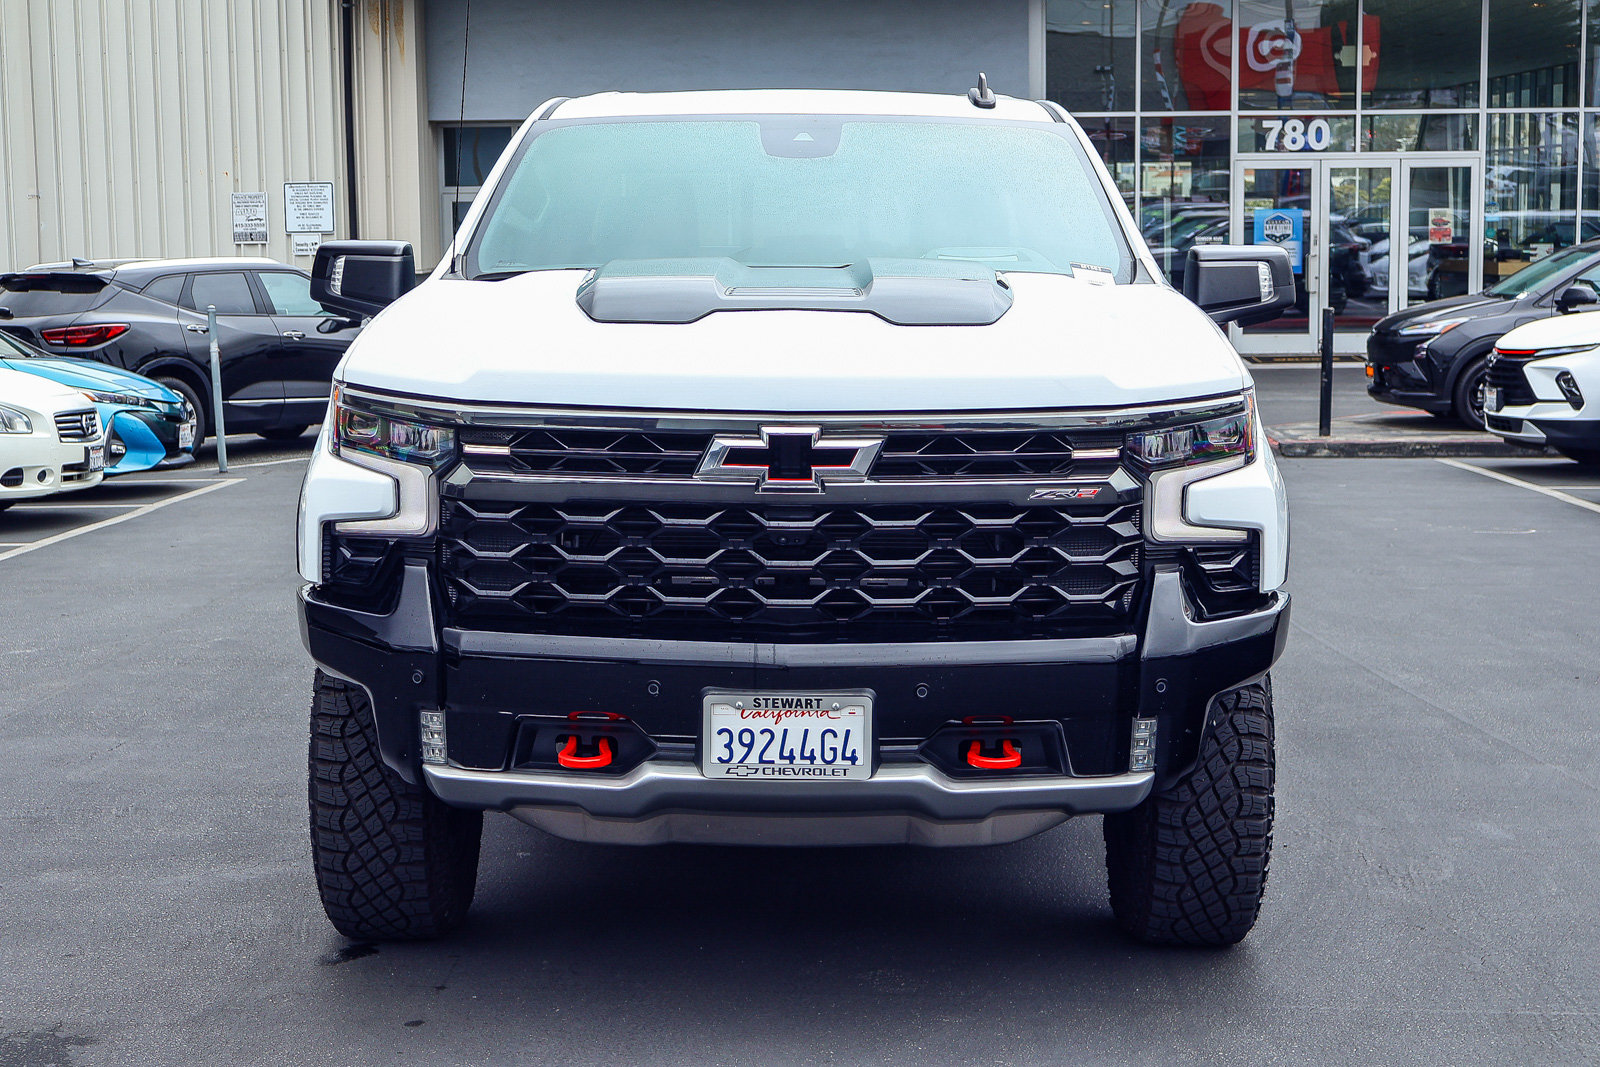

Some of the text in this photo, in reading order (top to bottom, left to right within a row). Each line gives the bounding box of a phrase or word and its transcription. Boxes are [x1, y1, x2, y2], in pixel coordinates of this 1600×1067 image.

[1262, 119, 1330, 151] 780
[1027, 488, 1102, 500] ZR2
[753, 697, 823, 709] STEWART
[740, 709, 840, 725] California
[716, 728, 859, 765] 39244G4
[762, 767, 849, 776] CHEVROLET
